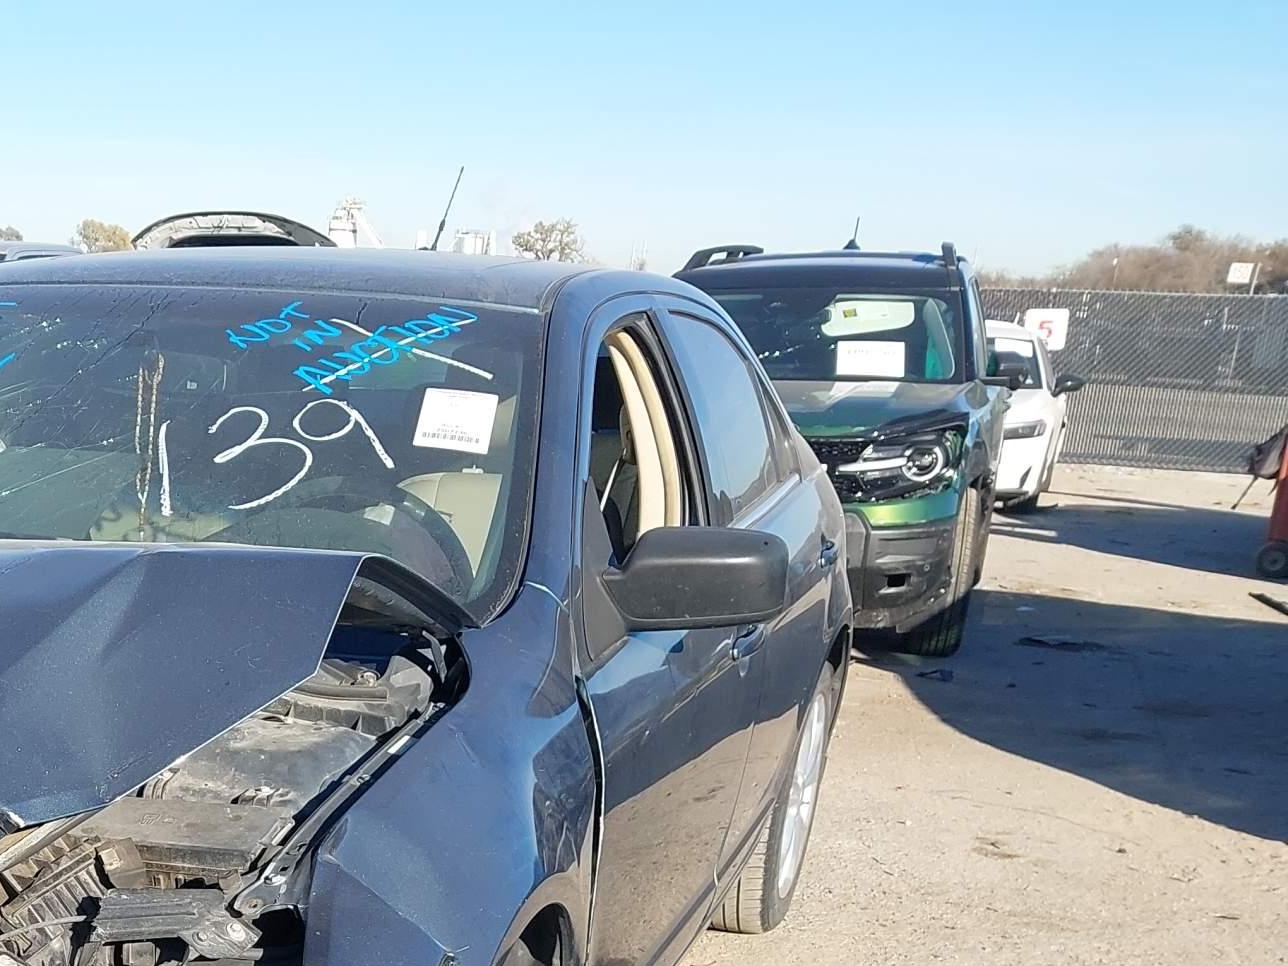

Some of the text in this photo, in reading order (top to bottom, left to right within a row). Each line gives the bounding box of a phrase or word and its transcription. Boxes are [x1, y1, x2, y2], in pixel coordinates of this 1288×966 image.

[226, 301, 310, 349] NOT
[293, 319, 343, 351] IN
[1037, 320, 1054, 339] 5
[293, 306, 478, 395] AUCTION
